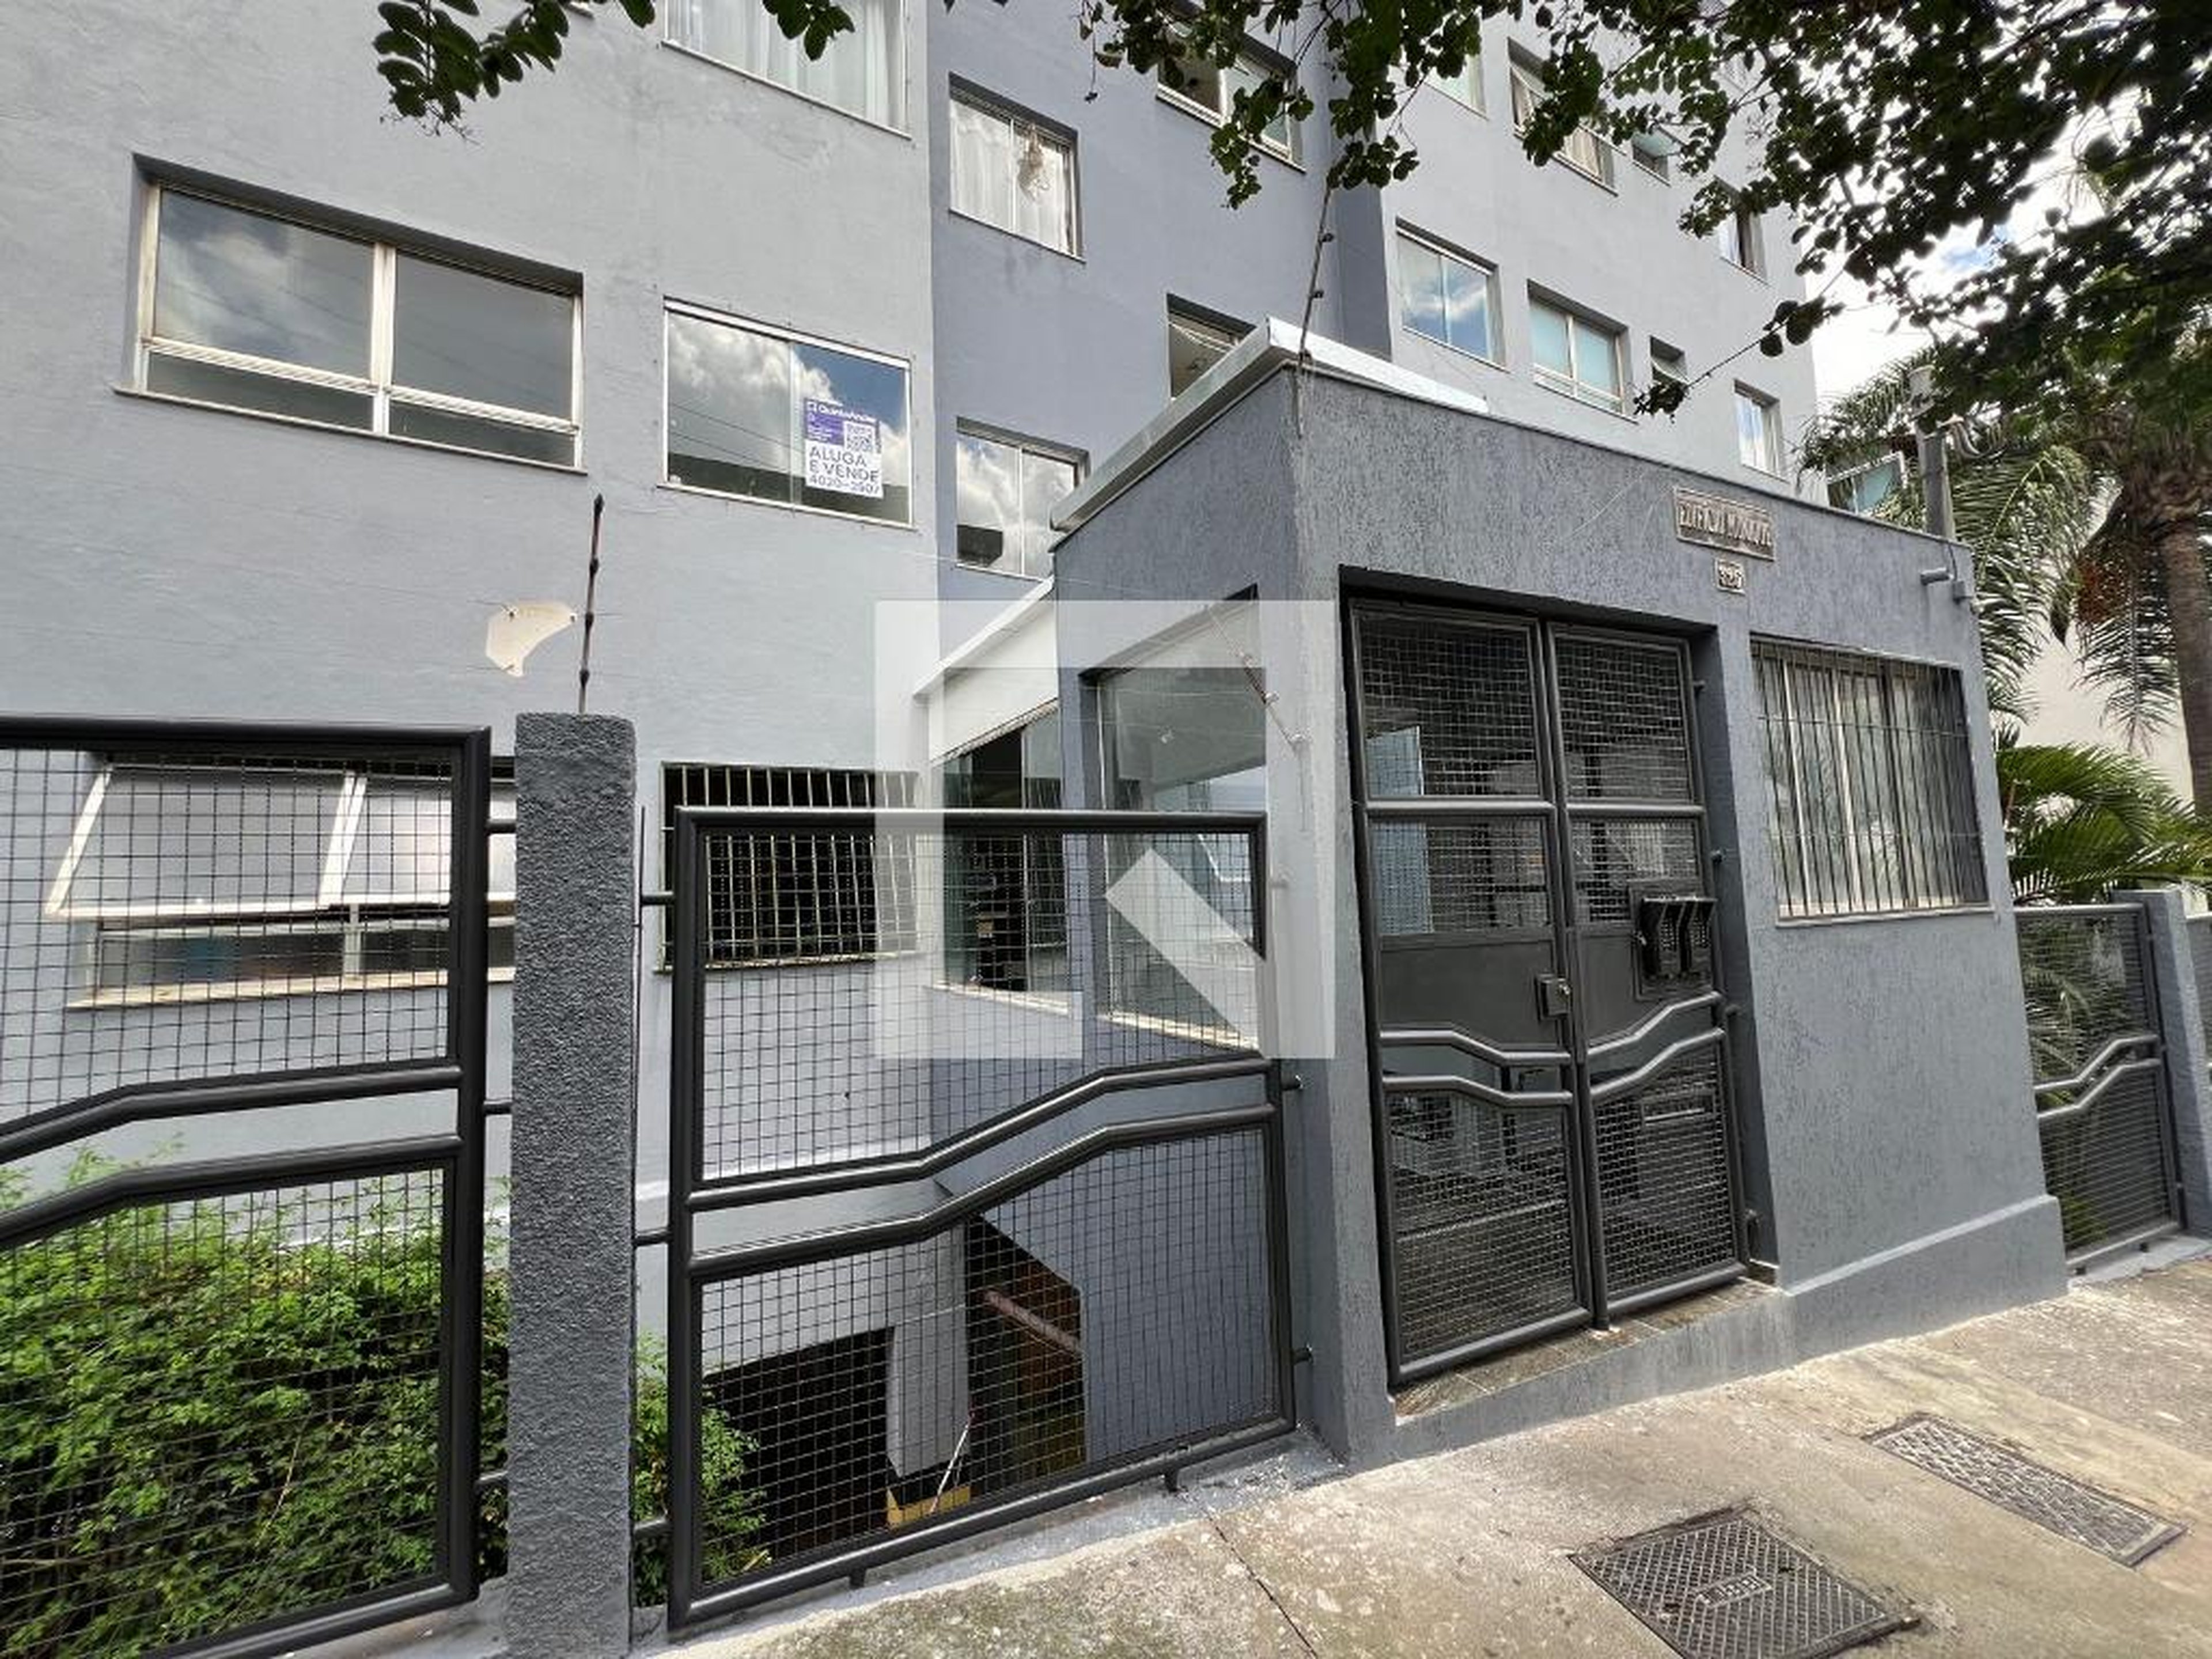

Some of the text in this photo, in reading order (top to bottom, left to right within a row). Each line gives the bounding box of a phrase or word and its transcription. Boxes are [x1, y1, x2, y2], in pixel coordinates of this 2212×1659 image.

[809, 446, 867, 467] ALUGA
[809, 460, 880, 482] E VENDE
